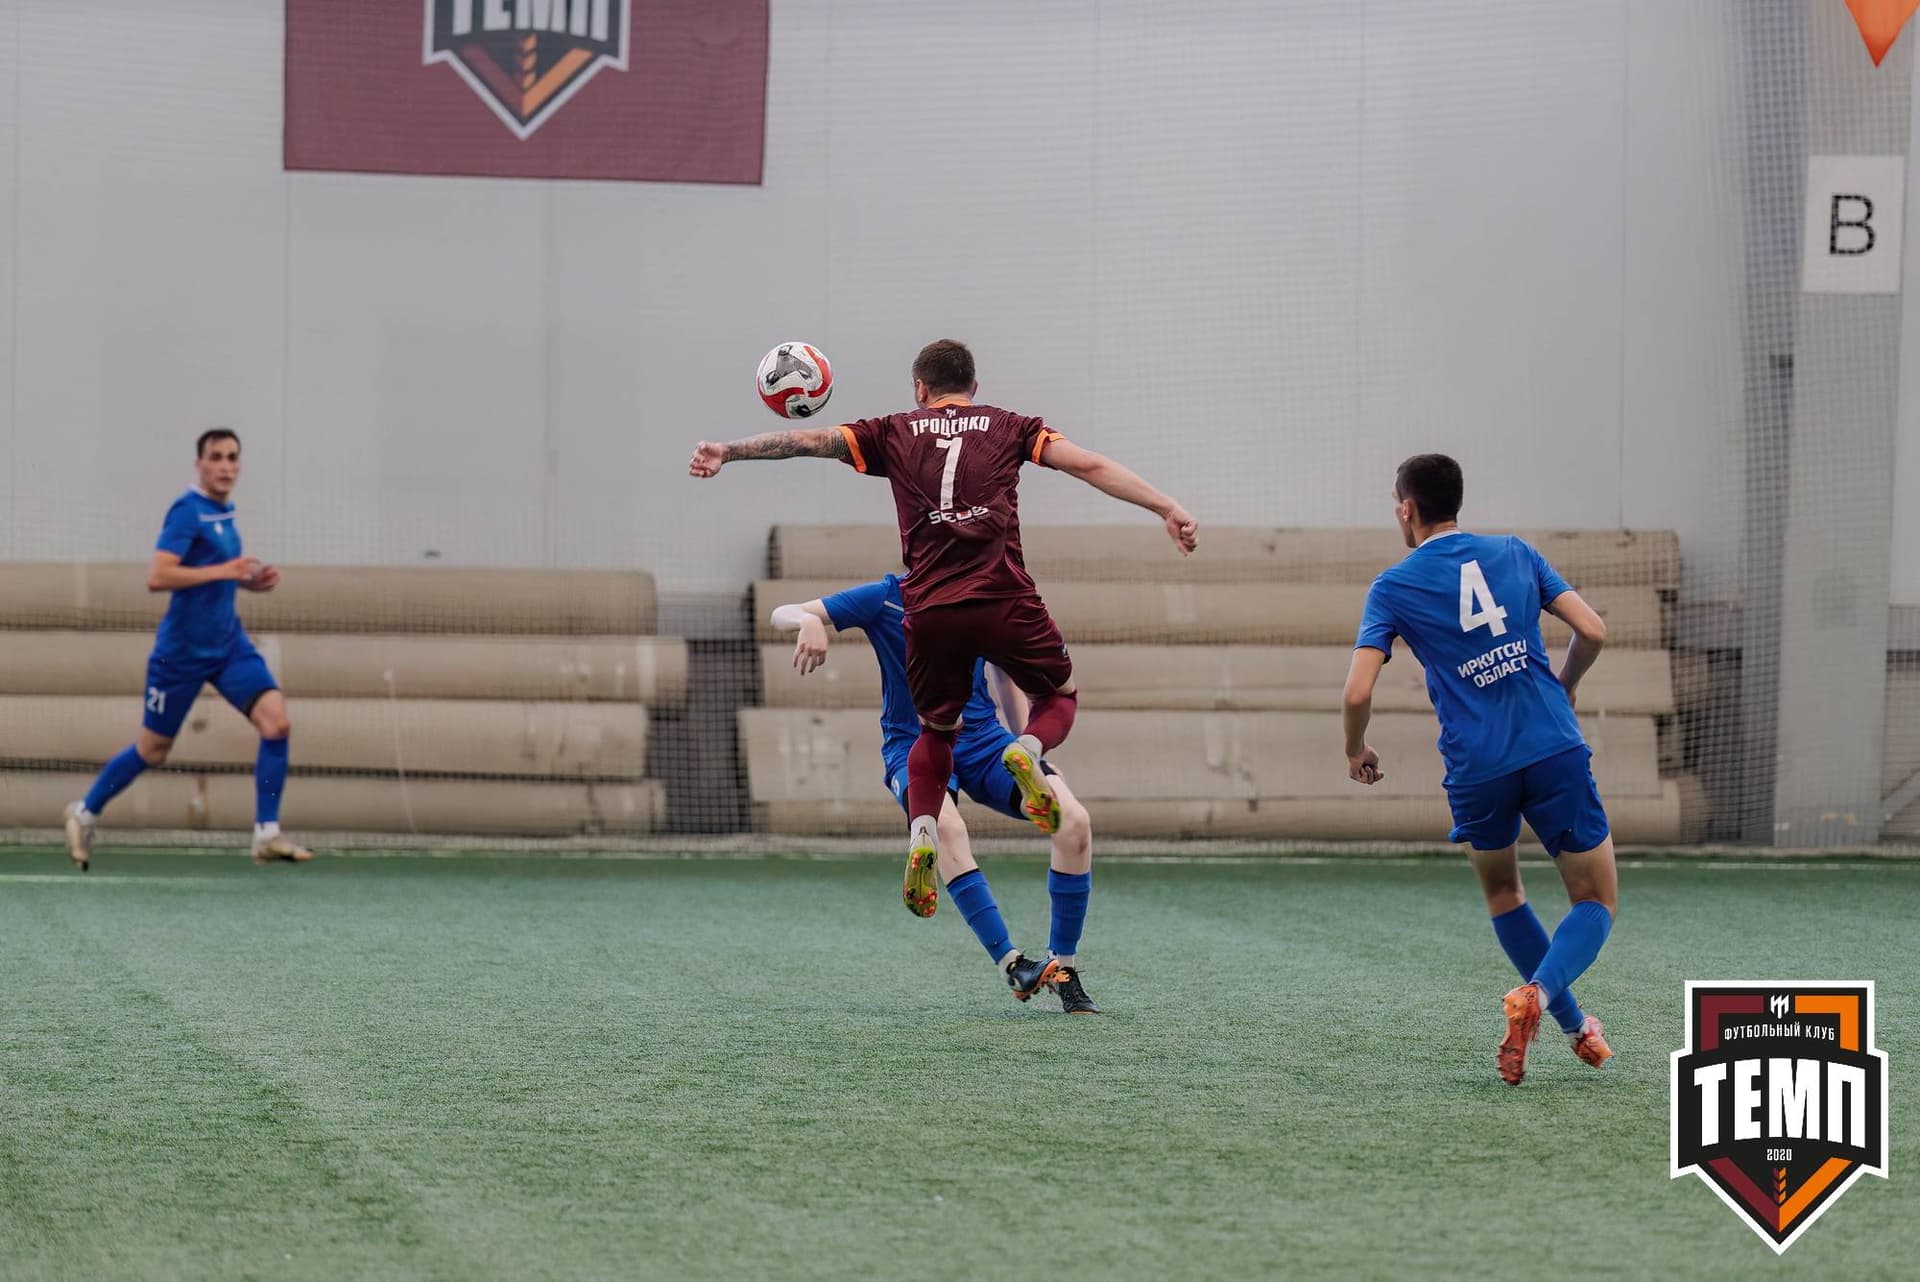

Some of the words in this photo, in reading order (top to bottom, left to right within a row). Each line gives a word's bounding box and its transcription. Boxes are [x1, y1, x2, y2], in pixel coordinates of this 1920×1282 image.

[909, 415, 990, 438] ТРОЦЕНКО
[936, 437, 963, 510] 7
[1459, 559, 1508, 637] 4
[147, 686, 166, 715] 21
